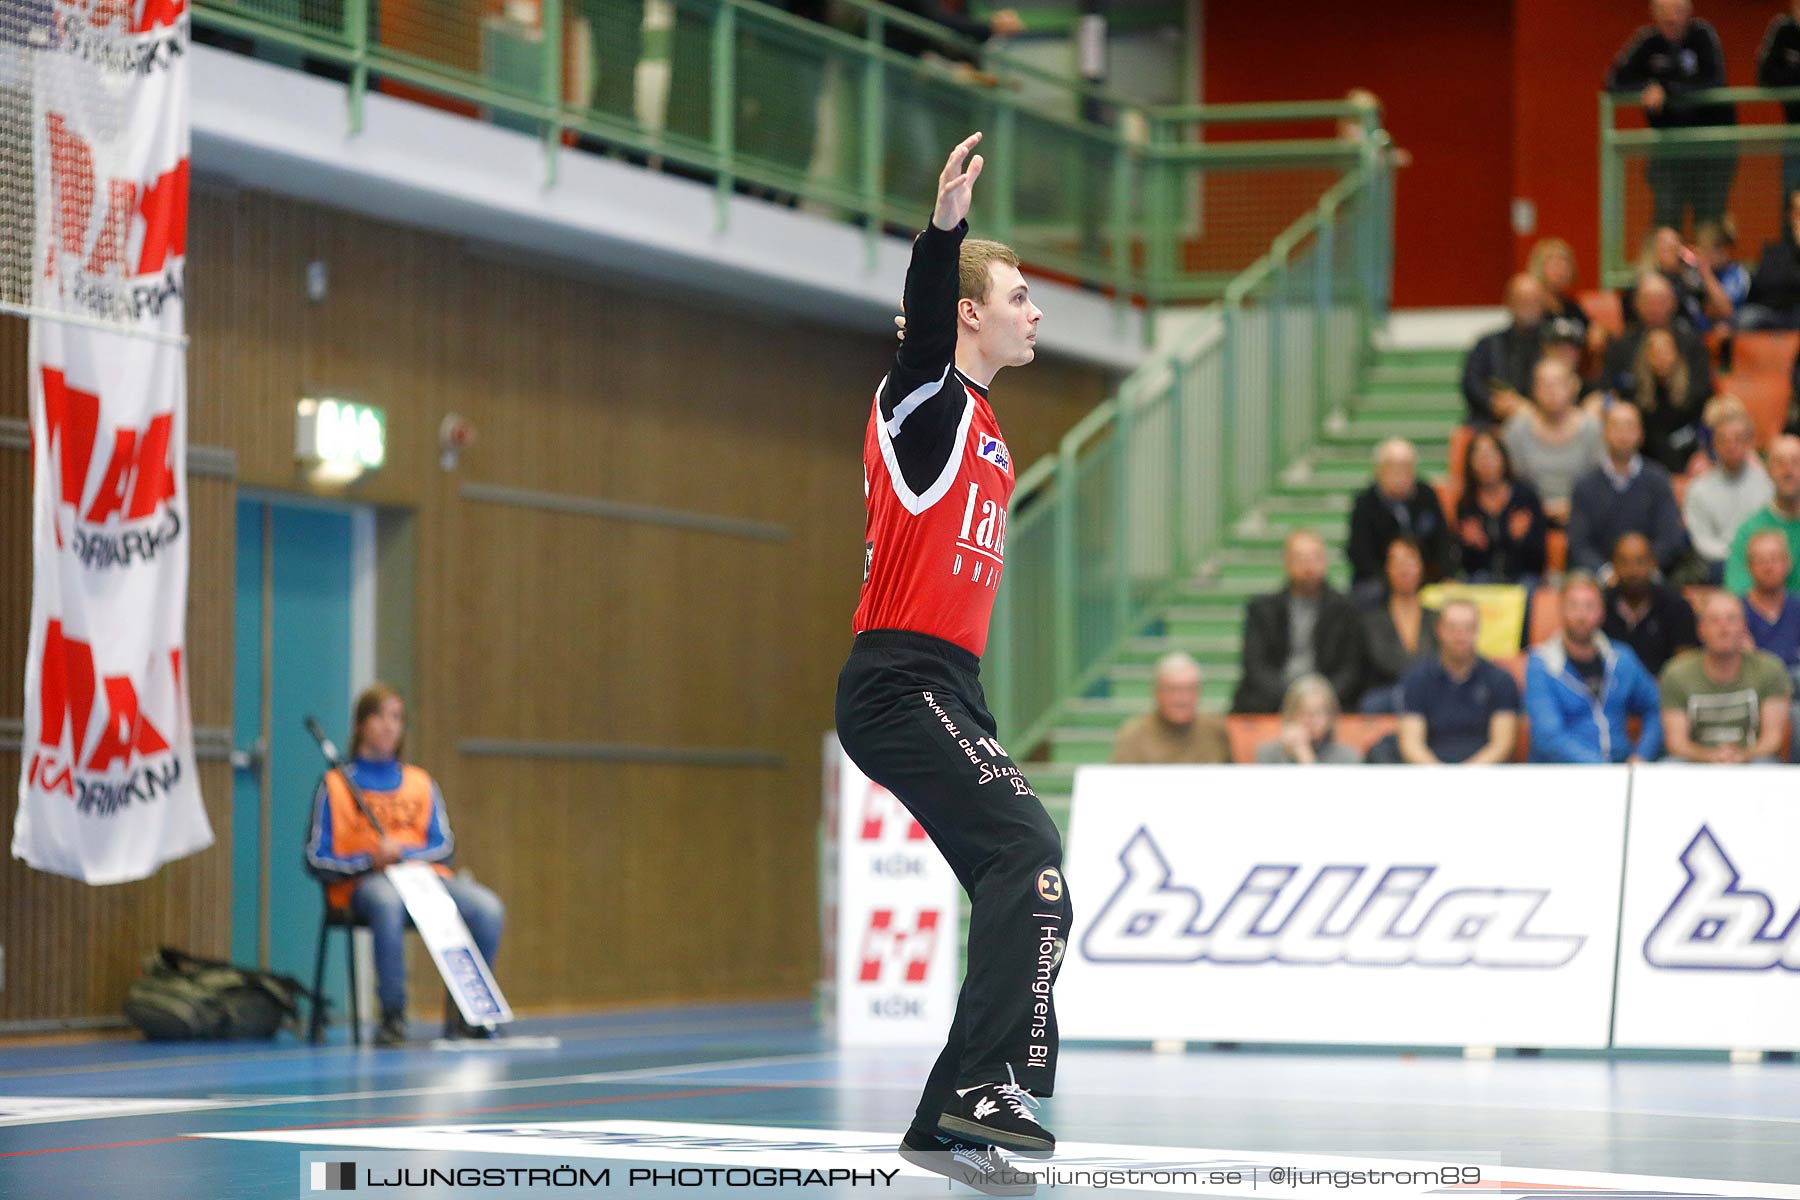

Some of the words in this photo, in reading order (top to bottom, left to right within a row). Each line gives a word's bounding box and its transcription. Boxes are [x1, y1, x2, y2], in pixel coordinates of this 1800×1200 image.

[922, 691, 961, 738] TRAINNG
[958, 738, 982, 765] PRO
[975, 737, 1009, 758] 16
[978, 762, 1026, 785] Sten
[1080, 824, 1590, 970] bilia
[1030, 926, 1060, 1038] Holmgrens
[1026, 1044, 1049, 1068] Bil
[950, 1143, 997, 1175] Salming
